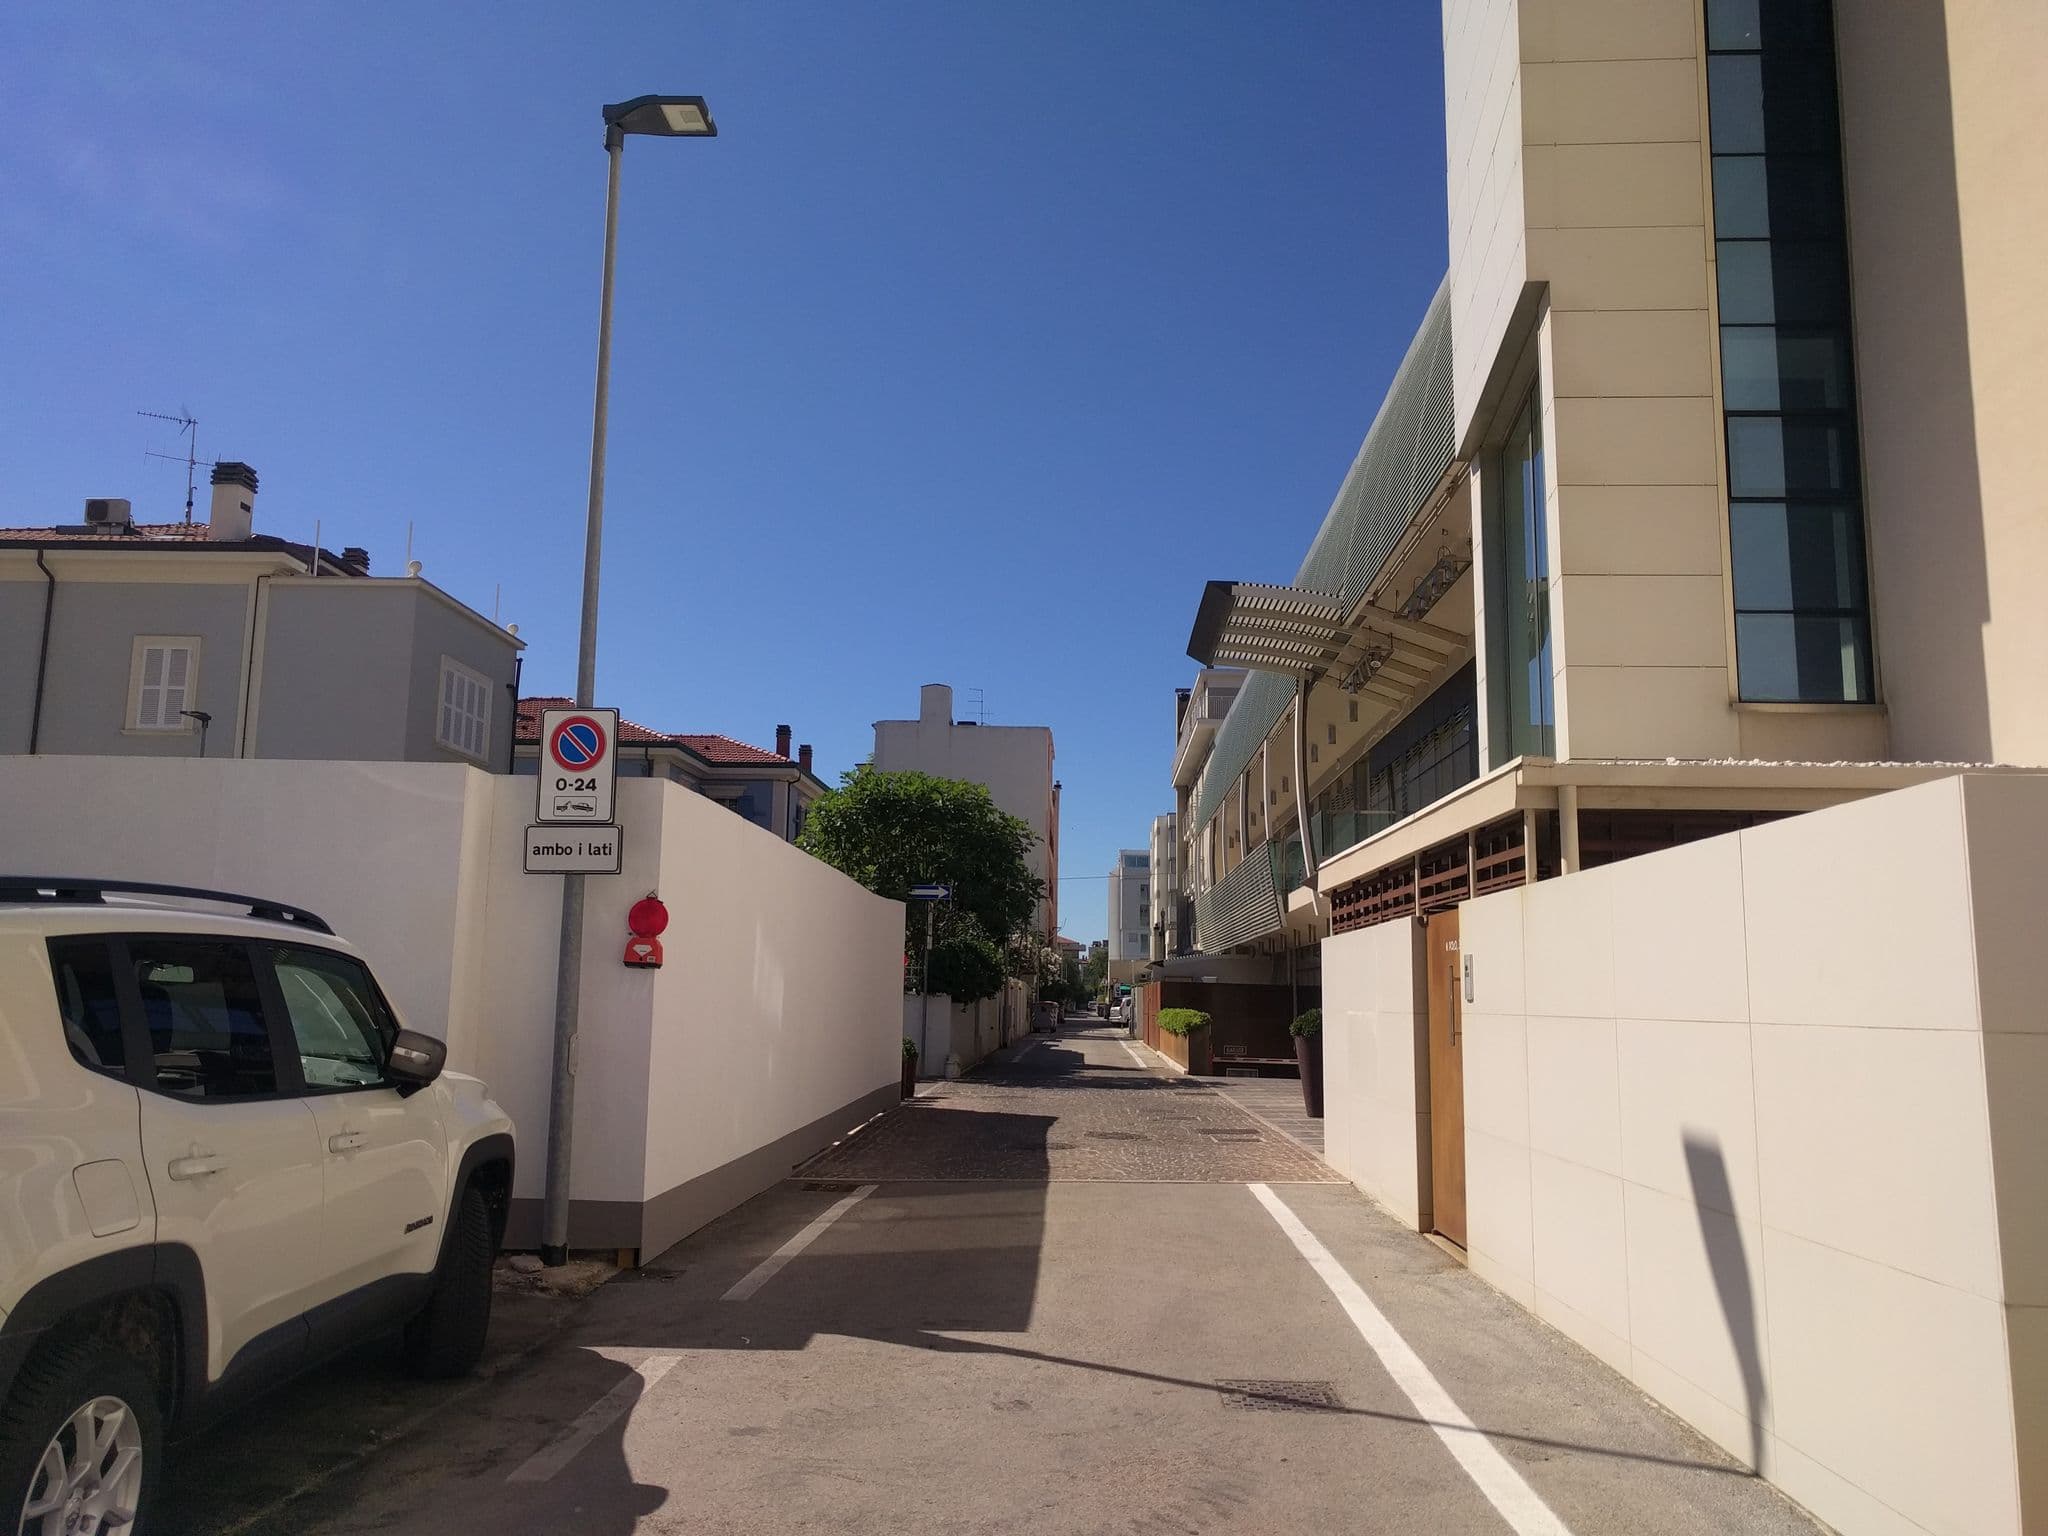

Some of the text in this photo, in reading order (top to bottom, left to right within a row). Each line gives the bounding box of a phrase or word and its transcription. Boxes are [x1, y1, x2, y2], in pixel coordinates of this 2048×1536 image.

[555, 777, 597, 791] 0-24
[532, 842, 612, 856] ambo i lati
